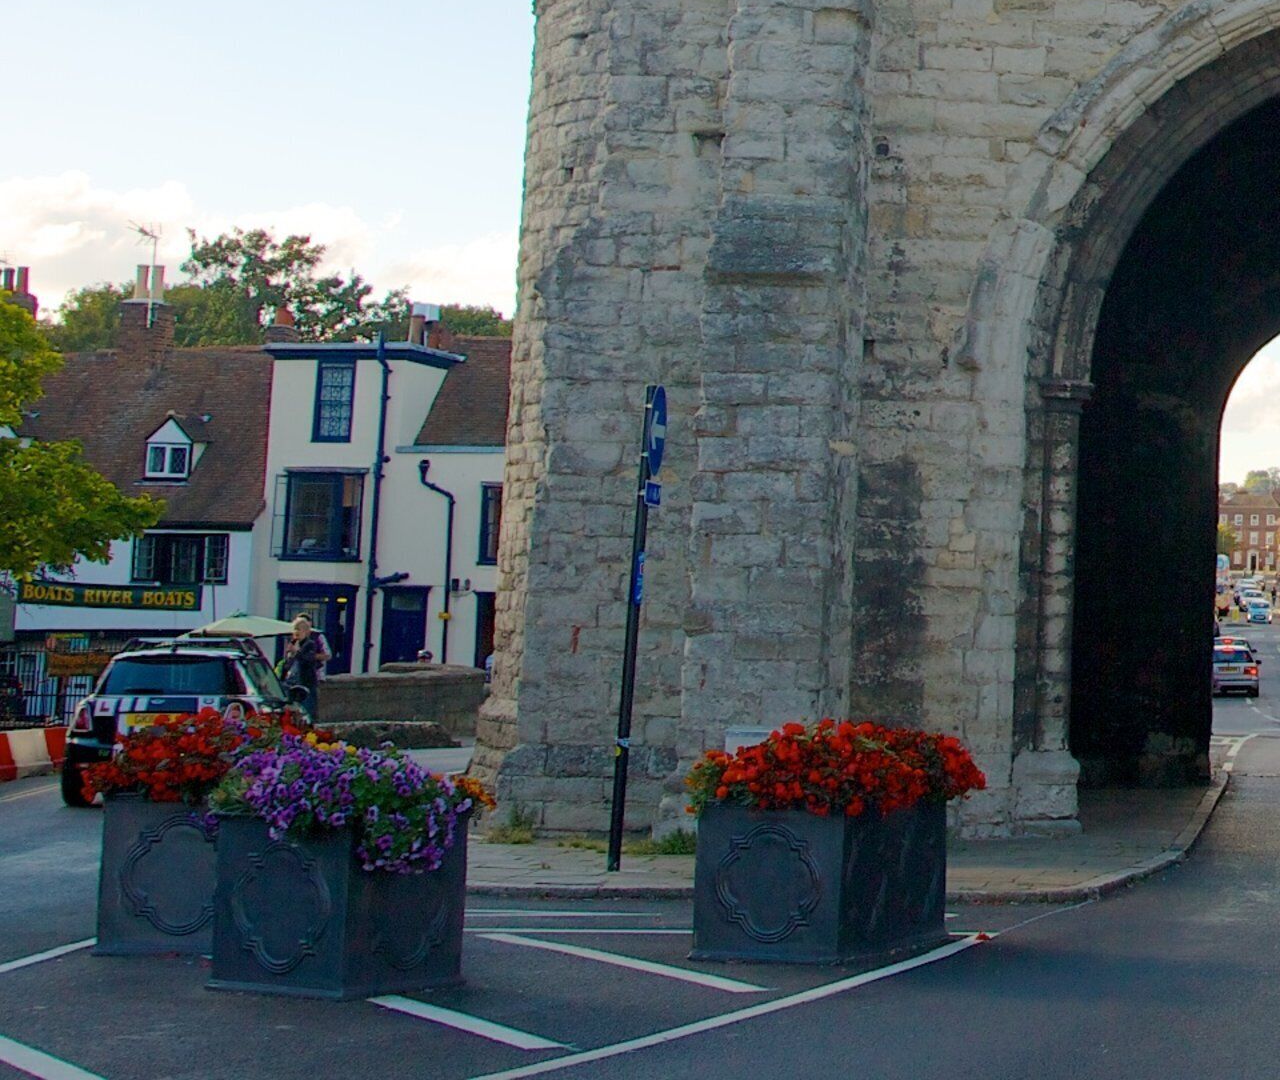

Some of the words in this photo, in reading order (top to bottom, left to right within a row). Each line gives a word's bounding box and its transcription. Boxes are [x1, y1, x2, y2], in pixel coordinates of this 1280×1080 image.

[22, 583, 75, 602] BOATS
[83, 588, 133, 605] RIVER
[142, 591, 195, 607] BOATS
